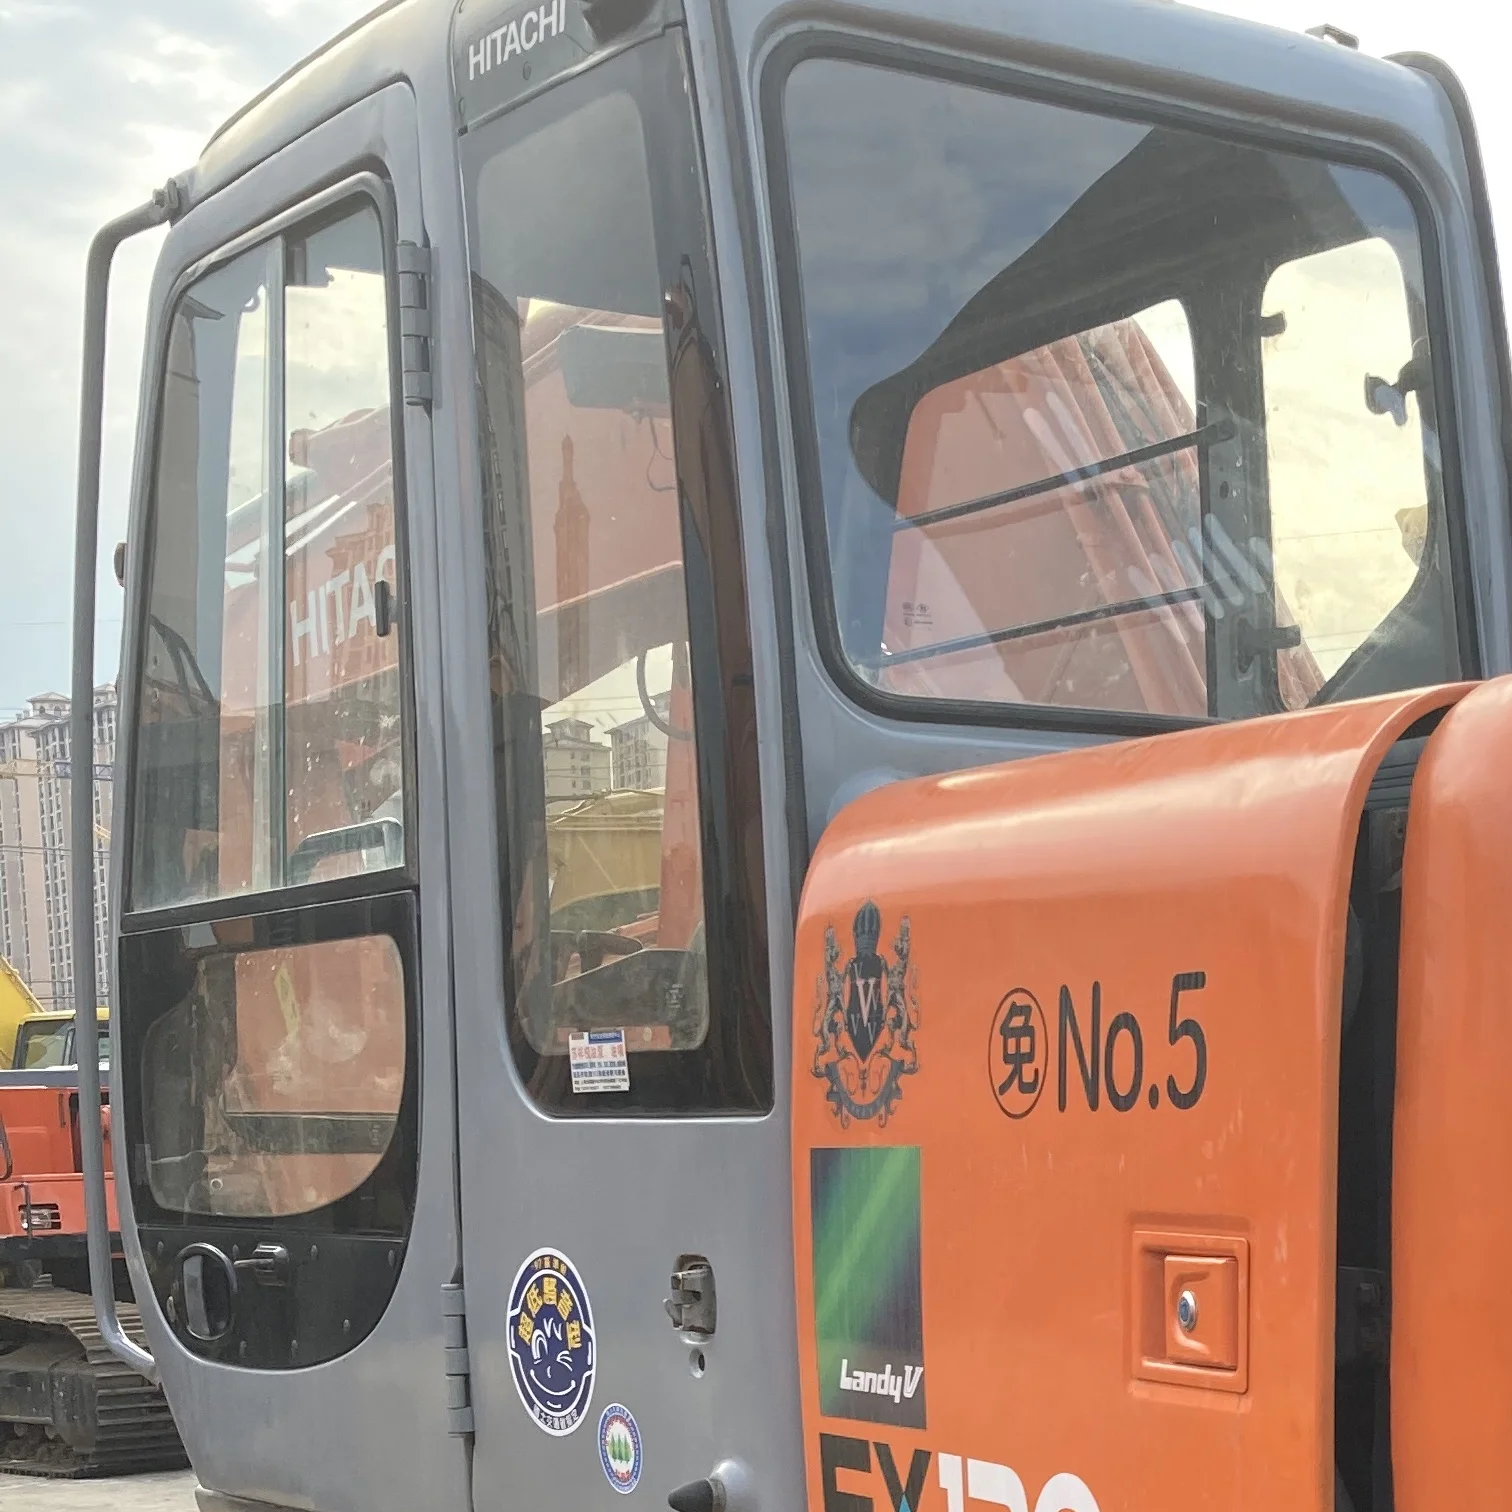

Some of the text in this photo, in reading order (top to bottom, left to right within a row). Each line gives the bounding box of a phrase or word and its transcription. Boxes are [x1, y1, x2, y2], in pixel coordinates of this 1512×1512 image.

[469, 0, 566, 81] HITACHI
[995, 970, 1207, 1113] 免 No.5
